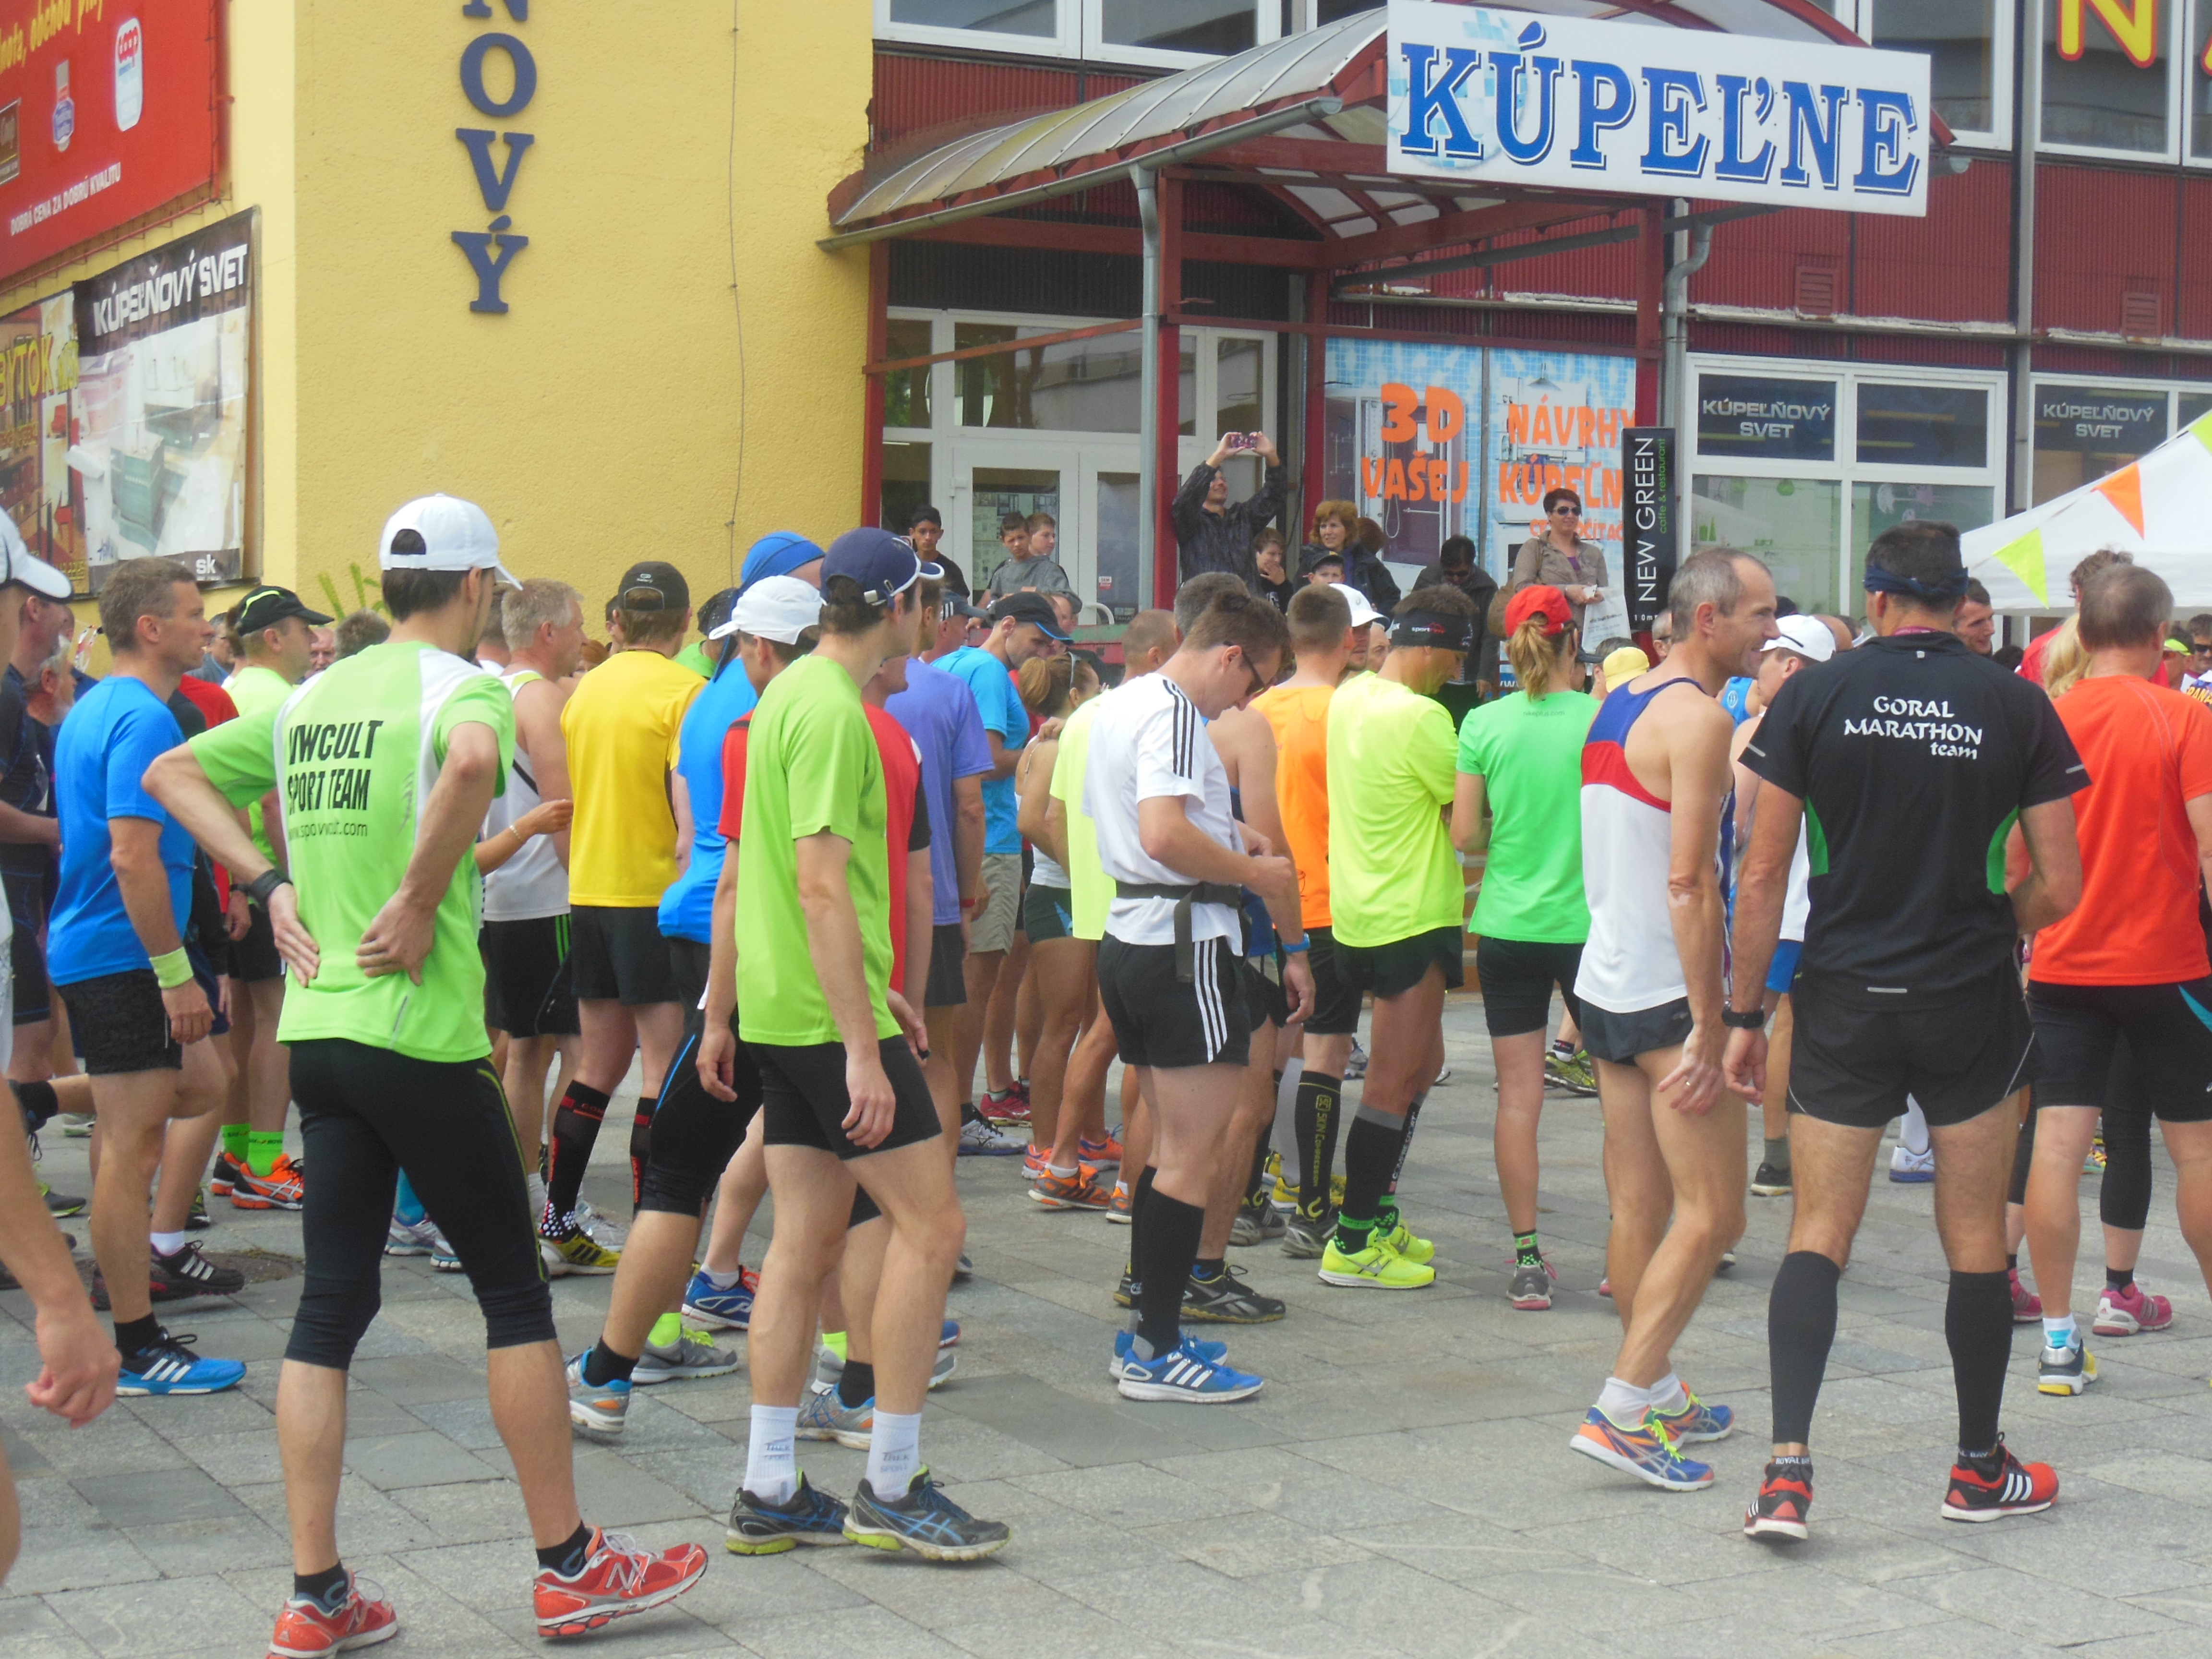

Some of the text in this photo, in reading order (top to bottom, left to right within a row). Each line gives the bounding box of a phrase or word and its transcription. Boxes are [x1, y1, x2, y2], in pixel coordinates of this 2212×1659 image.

[1400, 21, 1920, 197] KÚPEĽNE
[451, 0, 537, 313] OVÝ
[93, 244, 248, 336] KÚPEĽŇOVÝ SVET
[1381, 383, 1464, 444] 3D
[1703, 397, 1830, 421] KÚPEĽŇOVÝ
[2044, 402, 2155, 422] KÚPEĽŇOVÝ
[1740, 422, 1794, 438] SVET
[2076, 423, 2123, 438] SVET
[1361, 450, 1469, 503] VAŠEJ
[1577, 517, 1623, 541] OČÍTAČ
[1635, 438, 1657, 601] NEW GREEN
[195, 554, 216, 575] sk
[1873, 696, 1955, 718] GORAL
[1843, 718, 1983, 745] MARATHON
[1930, 741, 1978, 760] team
[288, 769, 371, 816] SPORT TEAM
